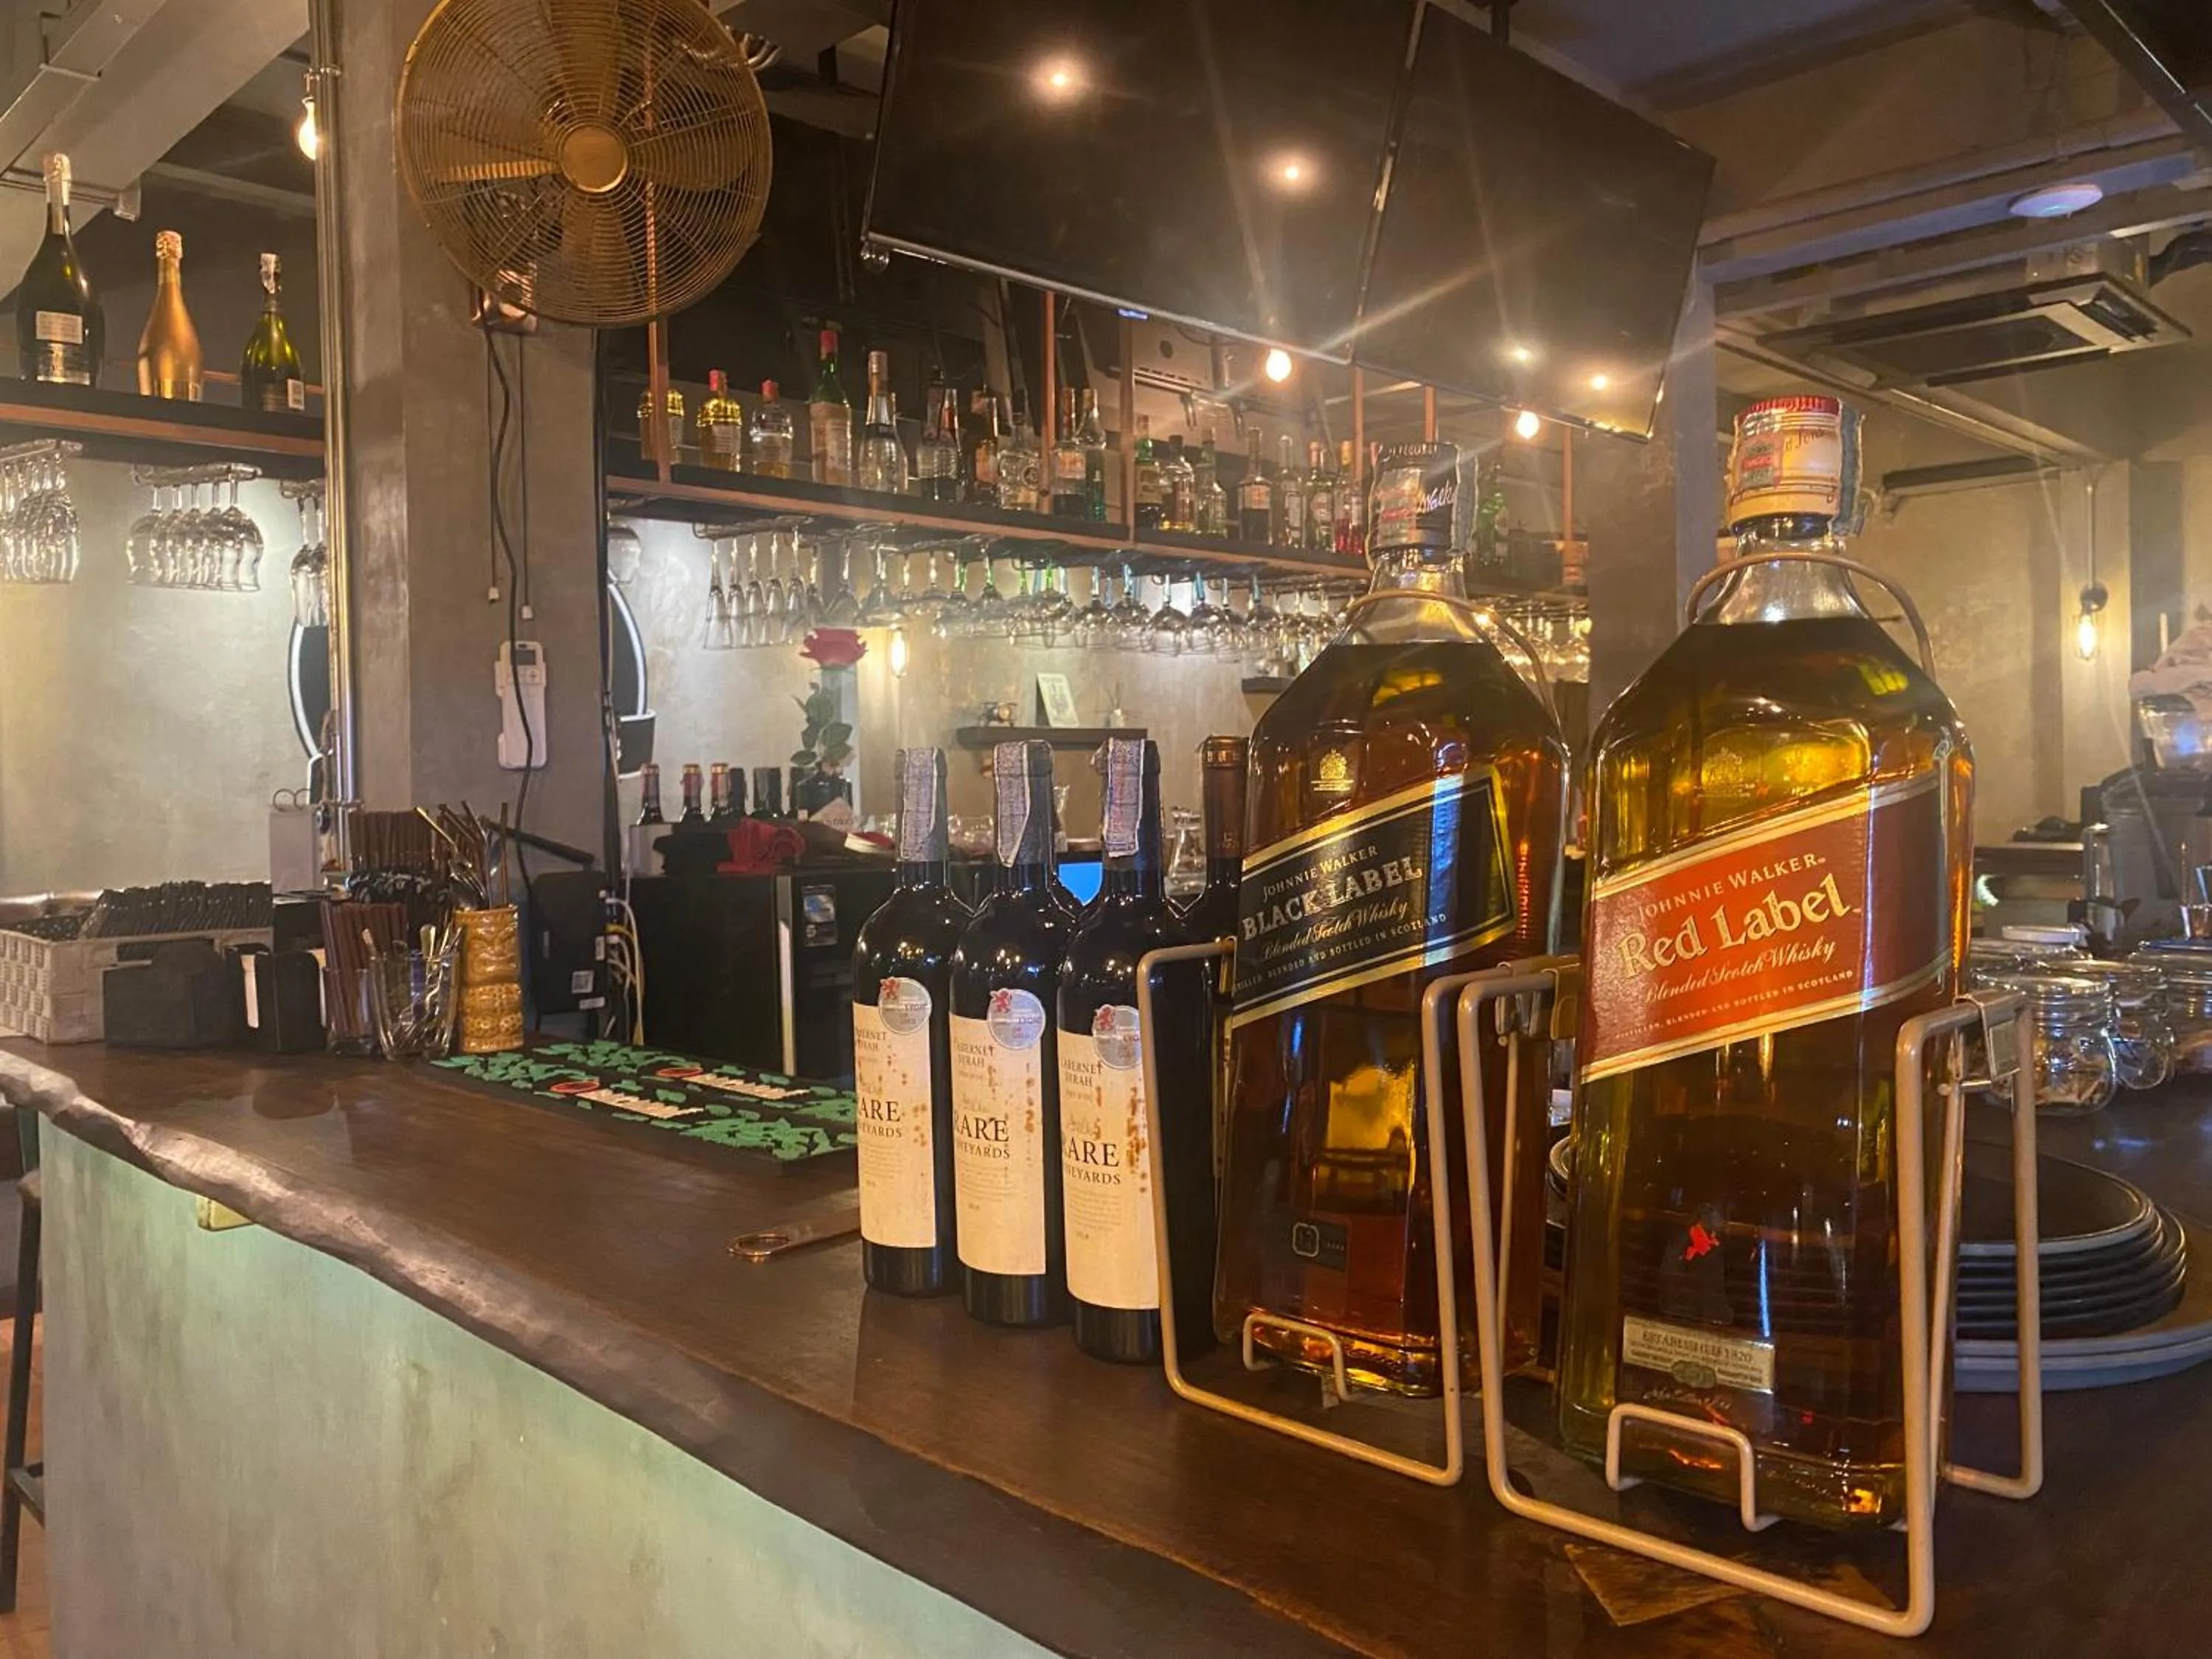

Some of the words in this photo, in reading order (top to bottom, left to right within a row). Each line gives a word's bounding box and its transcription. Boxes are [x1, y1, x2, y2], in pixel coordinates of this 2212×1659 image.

[1242, 890, 1321, 940] BLACK
[1325, 856, 1422, 908] LABEL
[1263, 868, 1318, 902] JOHNNIE
[1319, 846, 1377, 874] WALKER
[1638, 882, 1724, 928] JOHNNIE
[1728, 853, 1818, 889] WALKER
[1264, 926, 1312, 959] Blended
[1312, 914, 1352, 942] Scotch
[1354, 896, 1408, 928] Whisky
[1375, 931, 1387, 942] IN
[1390, 913, 1447, 936] SCOTLAND
[1618, 914, 1708, 978] Red
[1710, 872, 1851, 950] Label
[1645, 967, 1710, 1004] Blended
[1708, 956, 1764, 984] Scotch
[1764, 935, 1835, 968] Whisky
[1733, 989, 1779, 1007] BOTTLED
[1782, 985, 1795, 995] IN
[1798, 969, 1854, 991] SCOTLAND
[858, 1096, 901, 1122] ARE
